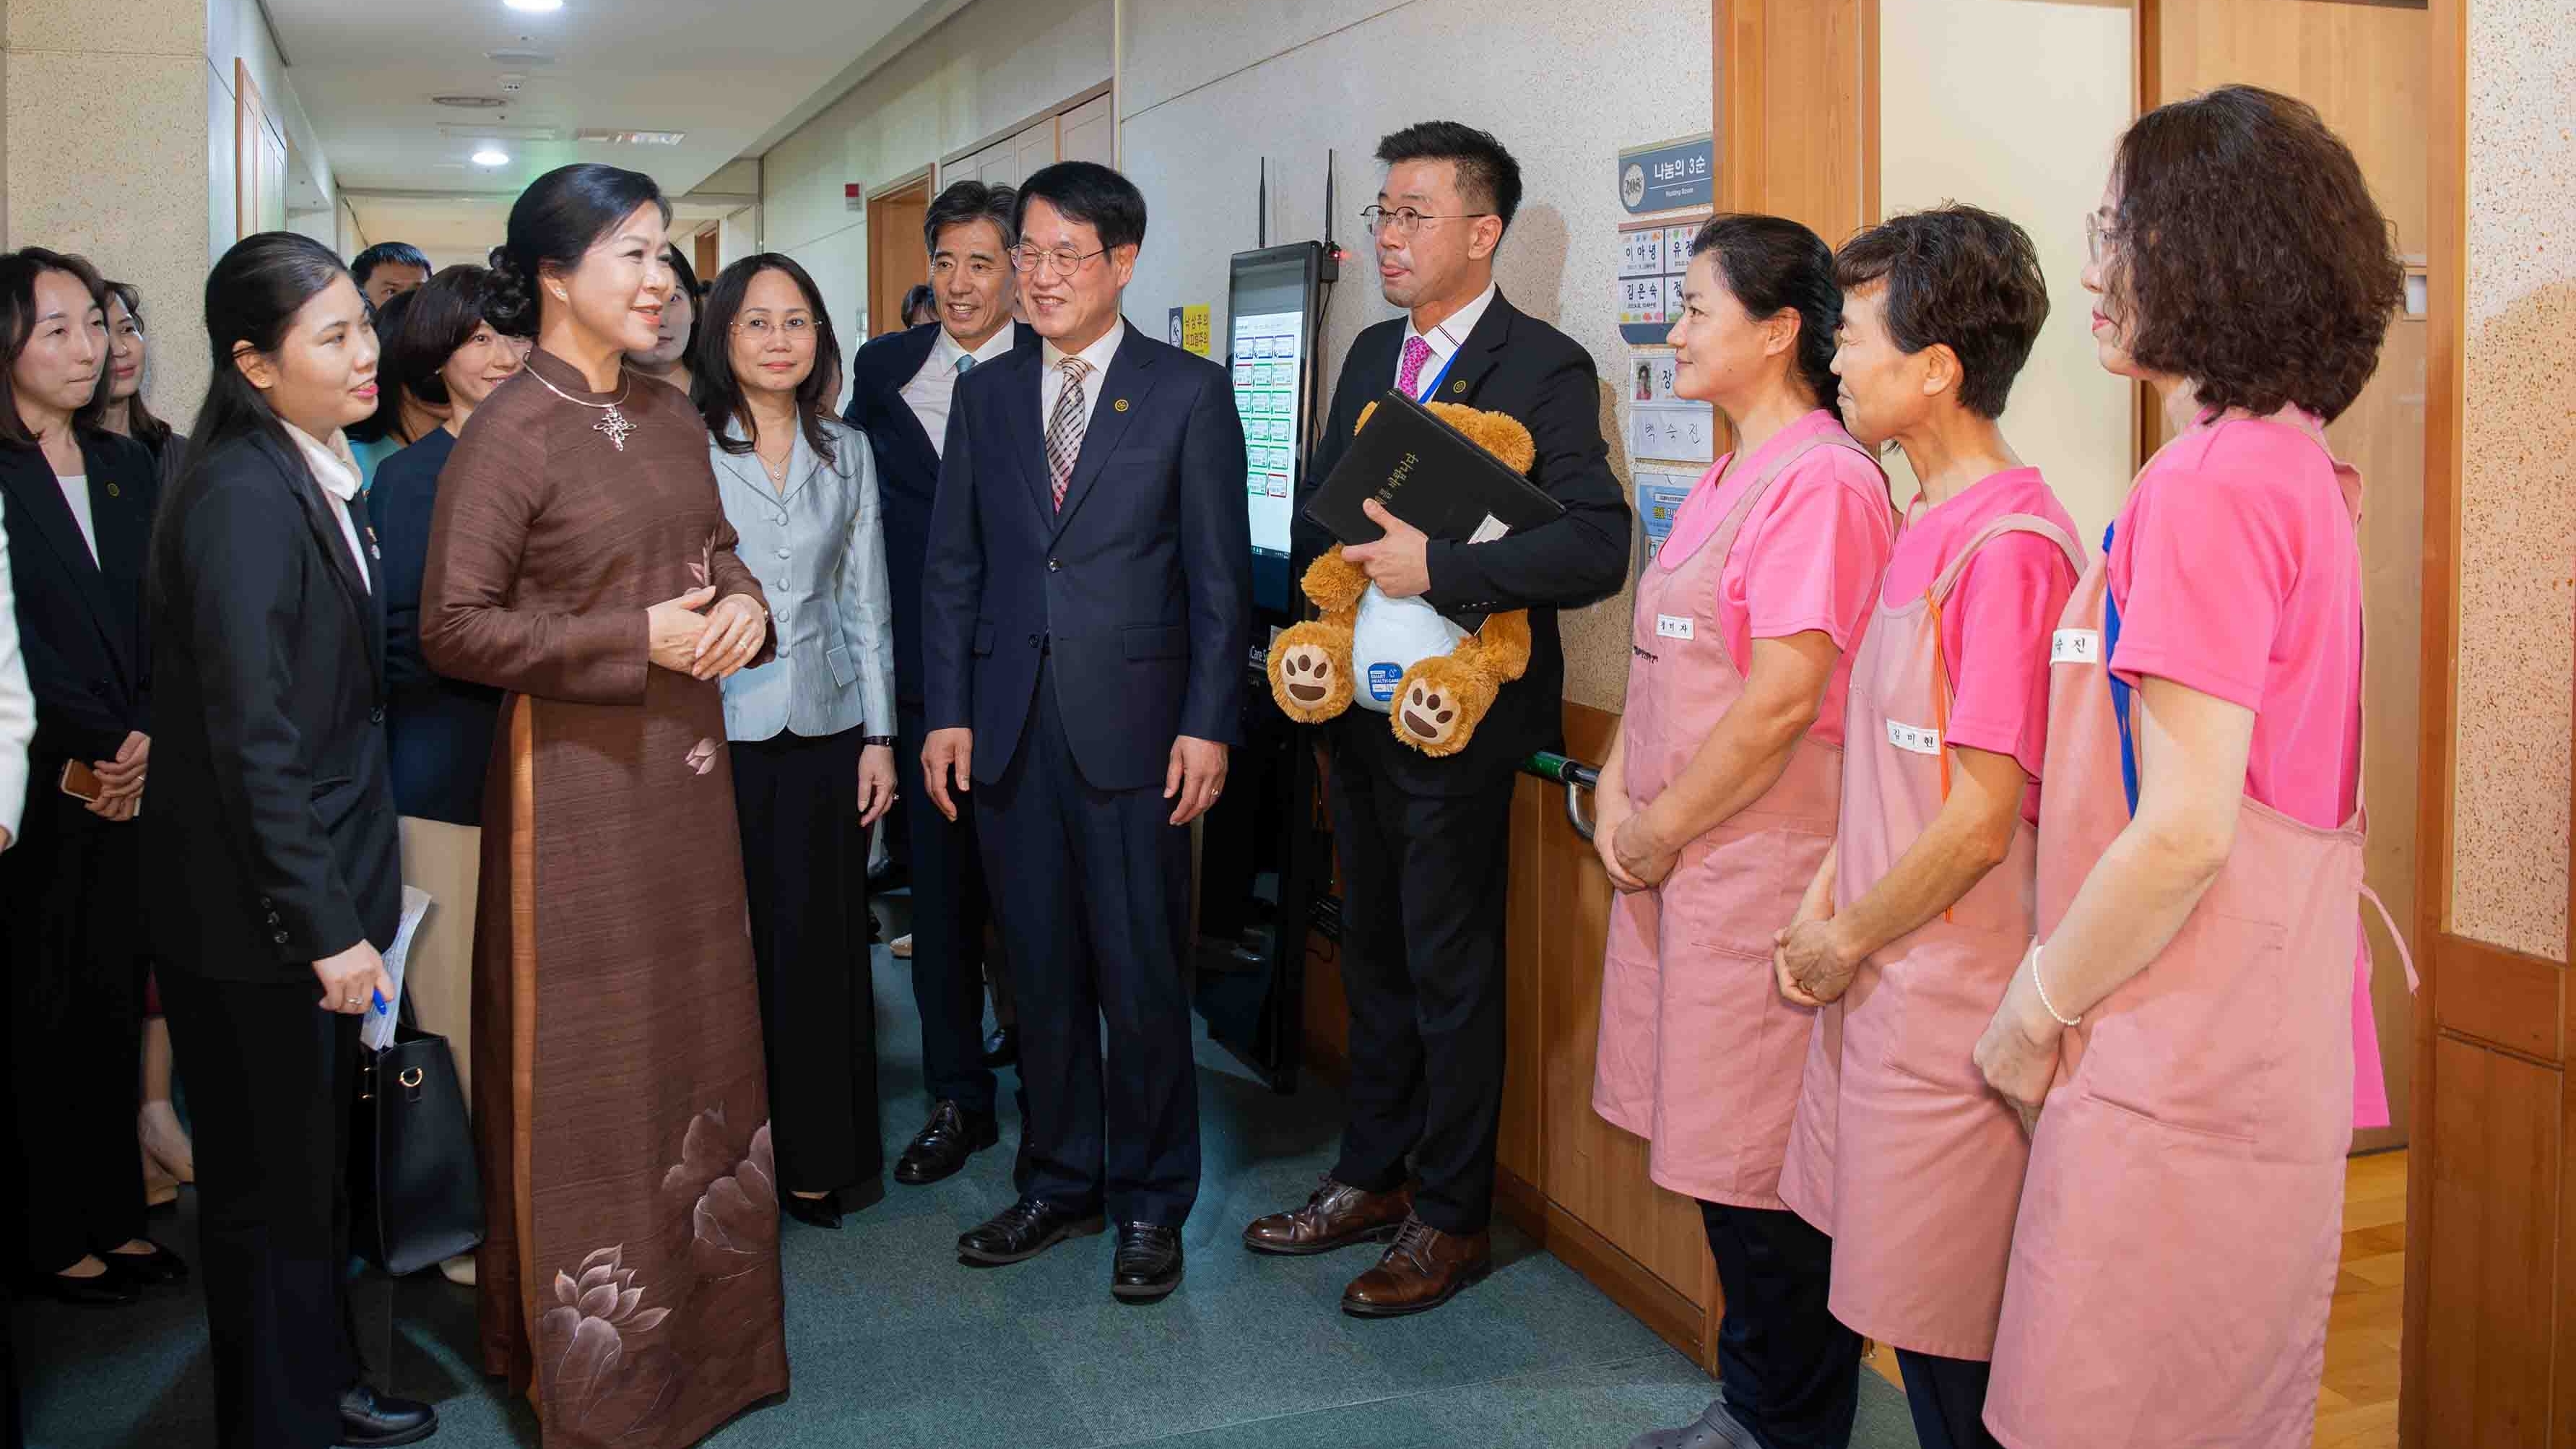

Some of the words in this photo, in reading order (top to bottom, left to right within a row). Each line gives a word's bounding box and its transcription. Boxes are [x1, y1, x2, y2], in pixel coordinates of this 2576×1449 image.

[1655, 159, 1684, 181] 나눔의
[1185, 313, 1207, 331] 낙상주의
[1662, 369, 1673, 389] 장
